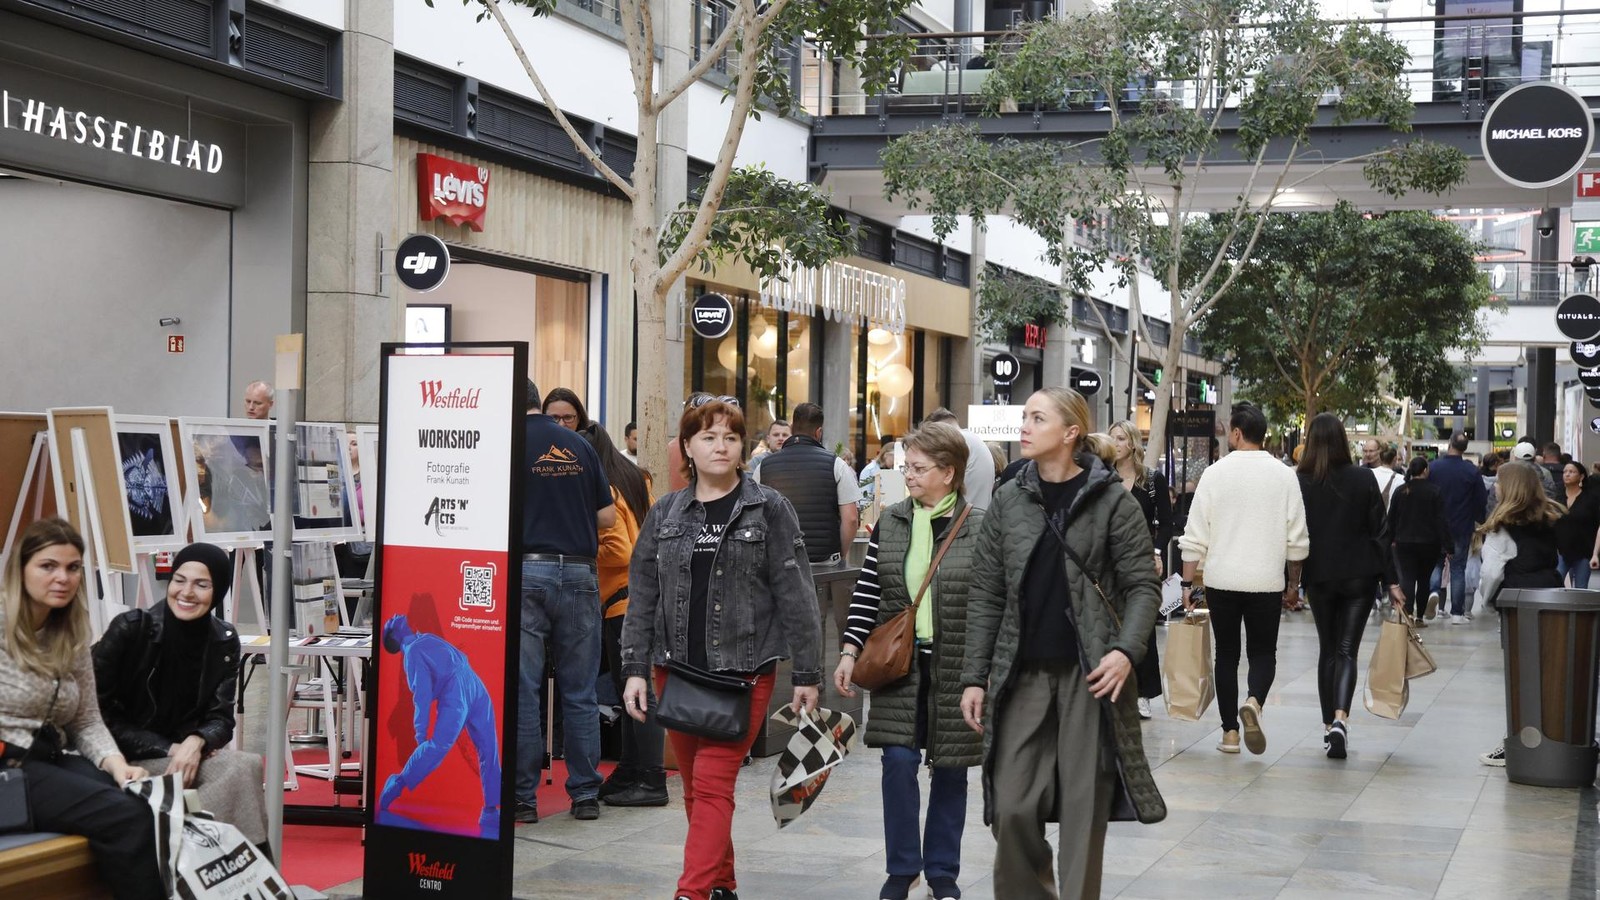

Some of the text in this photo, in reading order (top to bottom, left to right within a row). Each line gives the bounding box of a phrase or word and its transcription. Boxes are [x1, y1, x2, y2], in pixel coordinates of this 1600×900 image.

[22, 99, 223, 174] HASSELBLAD
[1492, 128, 1582, 140] MICHAEL KORS
[822, 258, 907, 336] OUTFITTERS
[996, 360, 1012, 376] UO
[419, 380, 482, 409] Westfield
[969, 425, 1021, 435] waterdro
[418, 429, 481, 449] WORKSHOP
[427, 462, 470, 475] Fotografie
[531, 465, 584, 474] FRANK KUNATH
[426, 475, 470, 485] Frank Kunath
[1161, 598, 1183, 615] PANDO
[408, 852, 456, 880] Westfield
[200, 864, 226, 886] Foot
[419, 878, 442, 891] CENTRO
